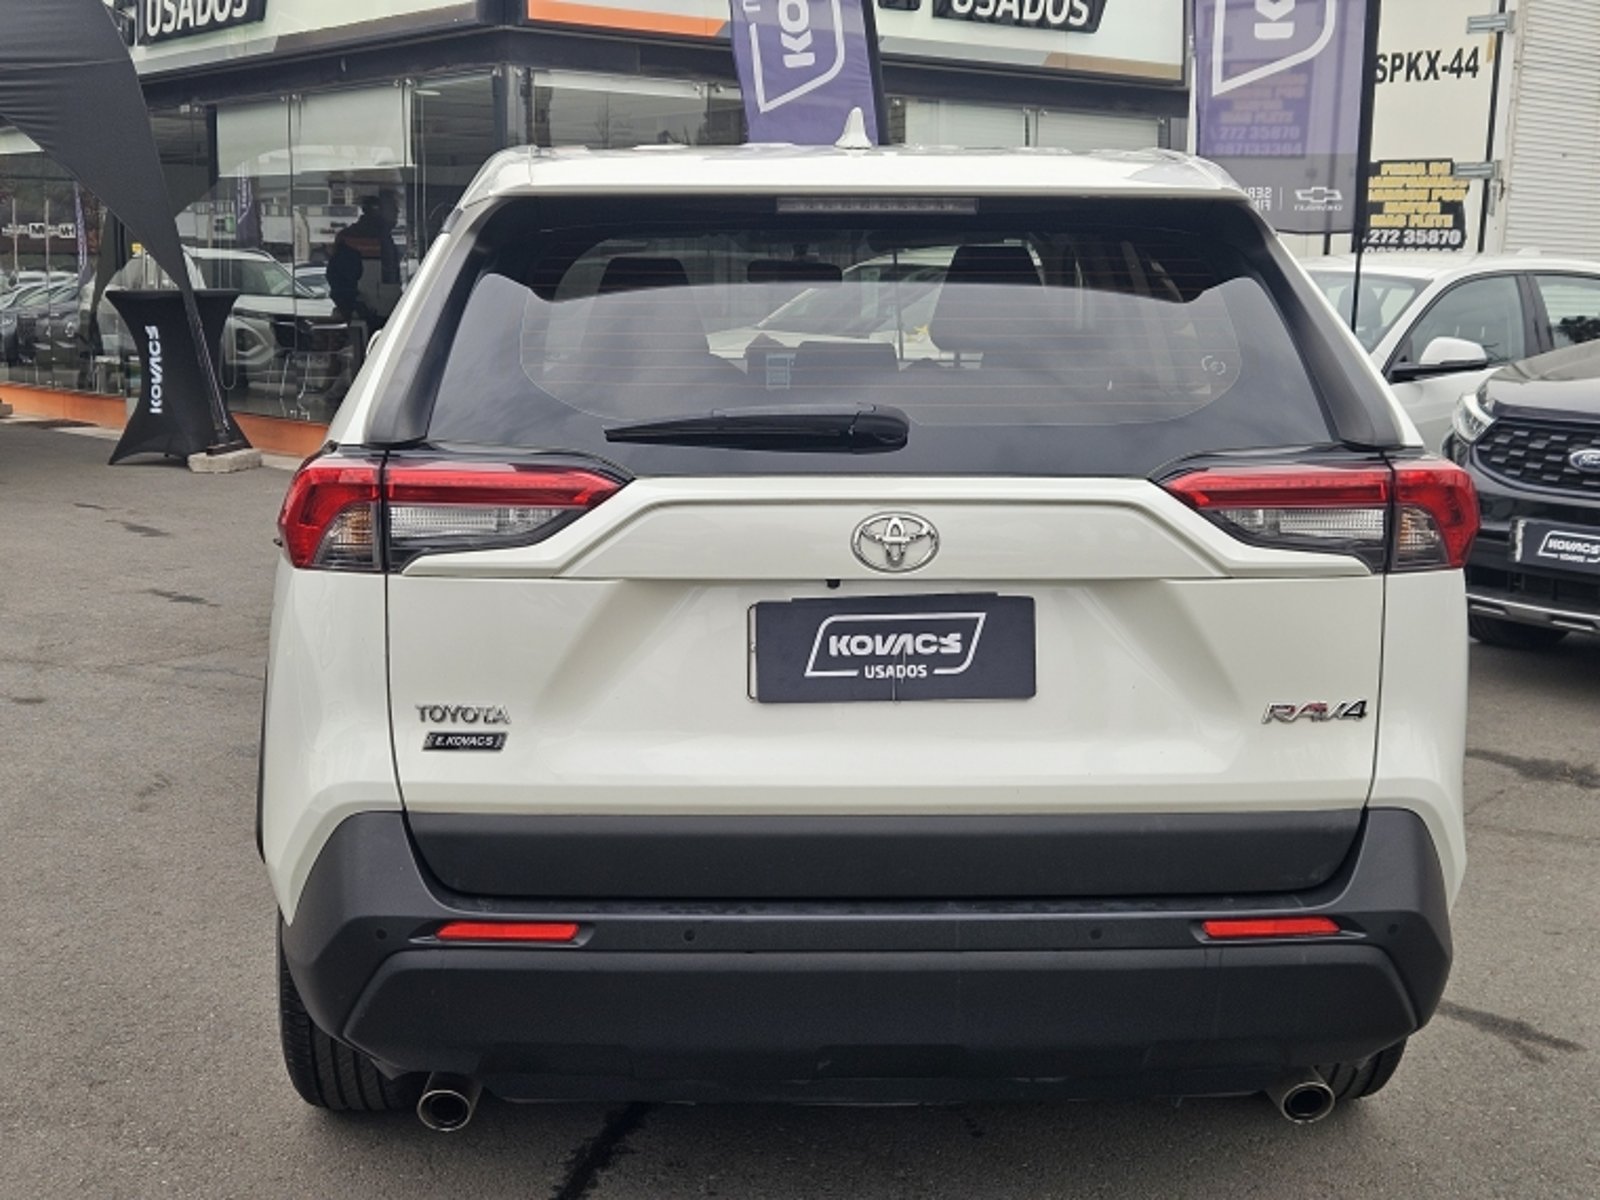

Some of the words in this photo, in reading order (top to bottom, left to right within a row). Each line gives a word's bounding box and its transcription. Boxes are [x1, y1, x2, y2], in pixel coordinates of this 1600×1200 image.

[1403, 229, 1461, 245] 35870
[144, 325, 162, 413] KOVACS
[828, 633, 962, 656] KOVACS
[864, 664, 928, 679] USADOS
[415, 705, 511, 724] TOYOTA
[1262, 699, 1367, 724] RAV4
